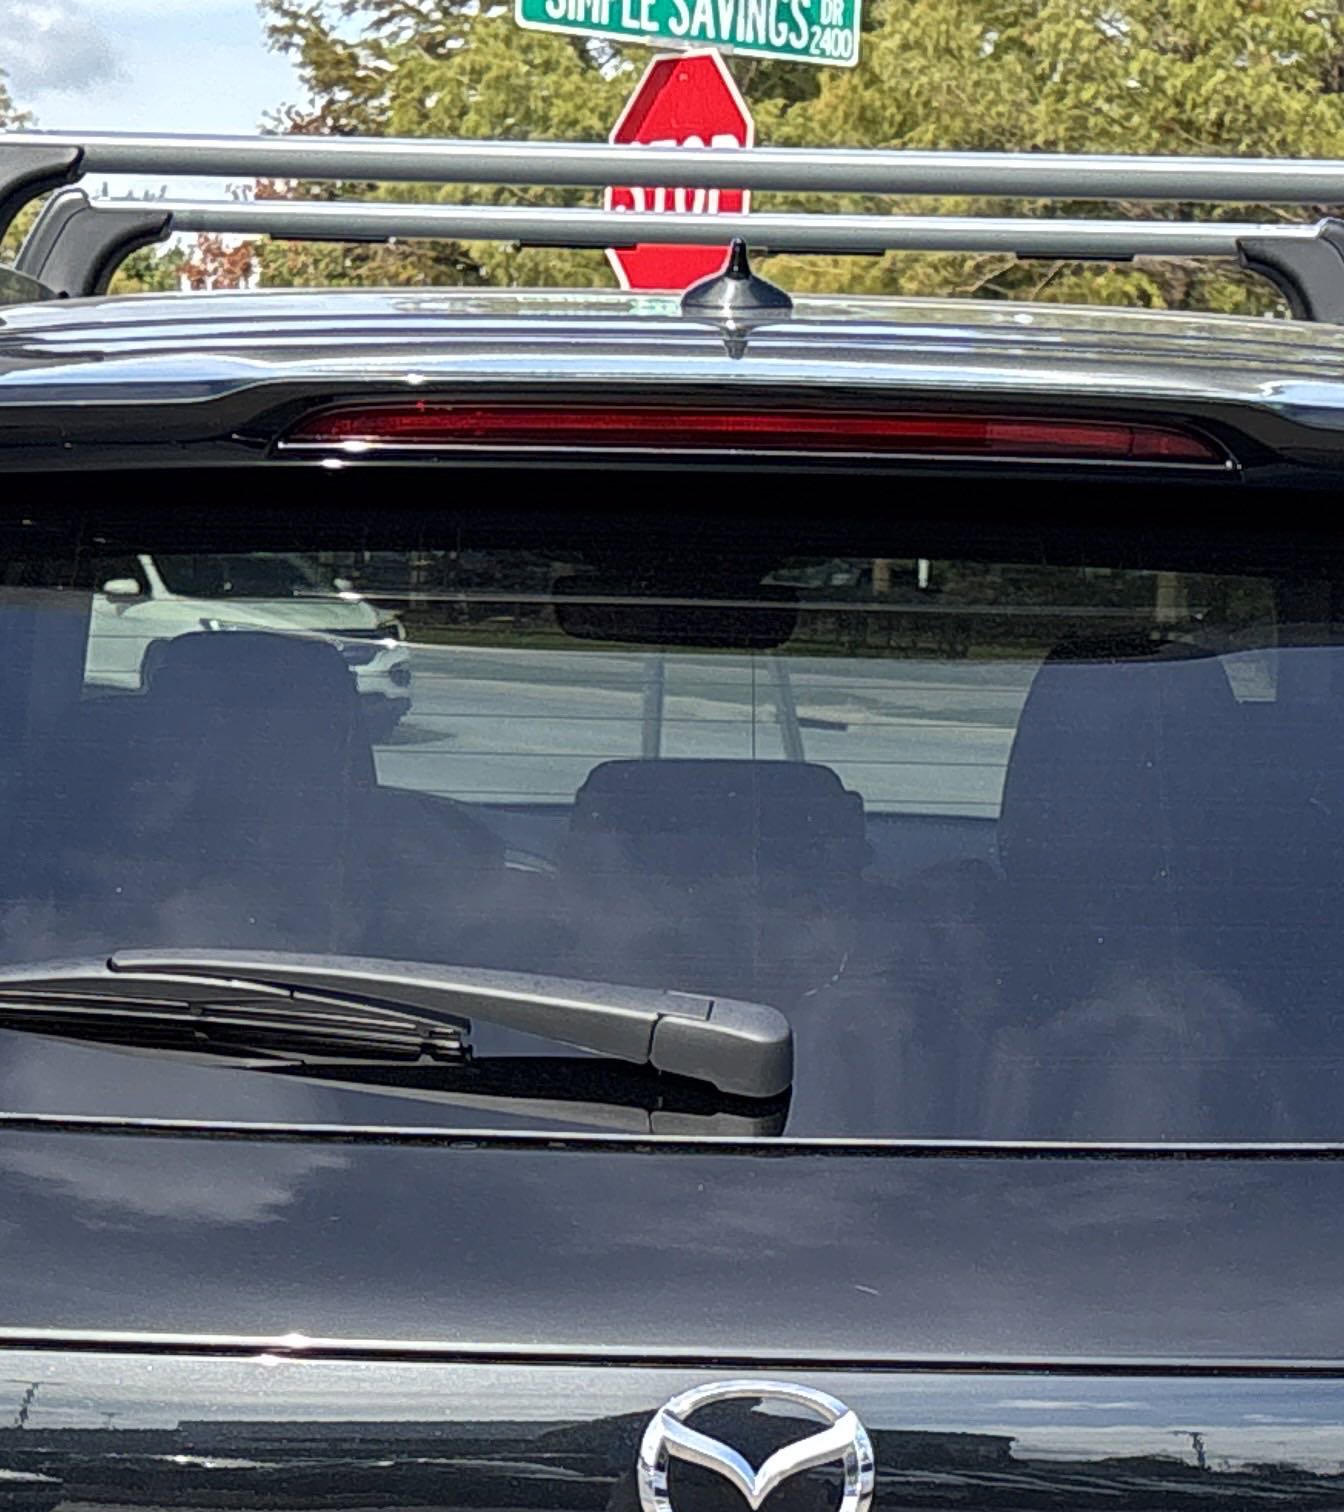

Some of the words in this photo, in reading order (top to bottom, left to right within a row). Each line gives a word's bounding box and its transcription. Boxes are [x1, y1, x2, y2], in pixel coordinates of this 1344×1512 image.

[668, 0, 810, 49] SAVINGS
[820, 0, 844, 26] DR
[809, 26, 853, 58] 2400
